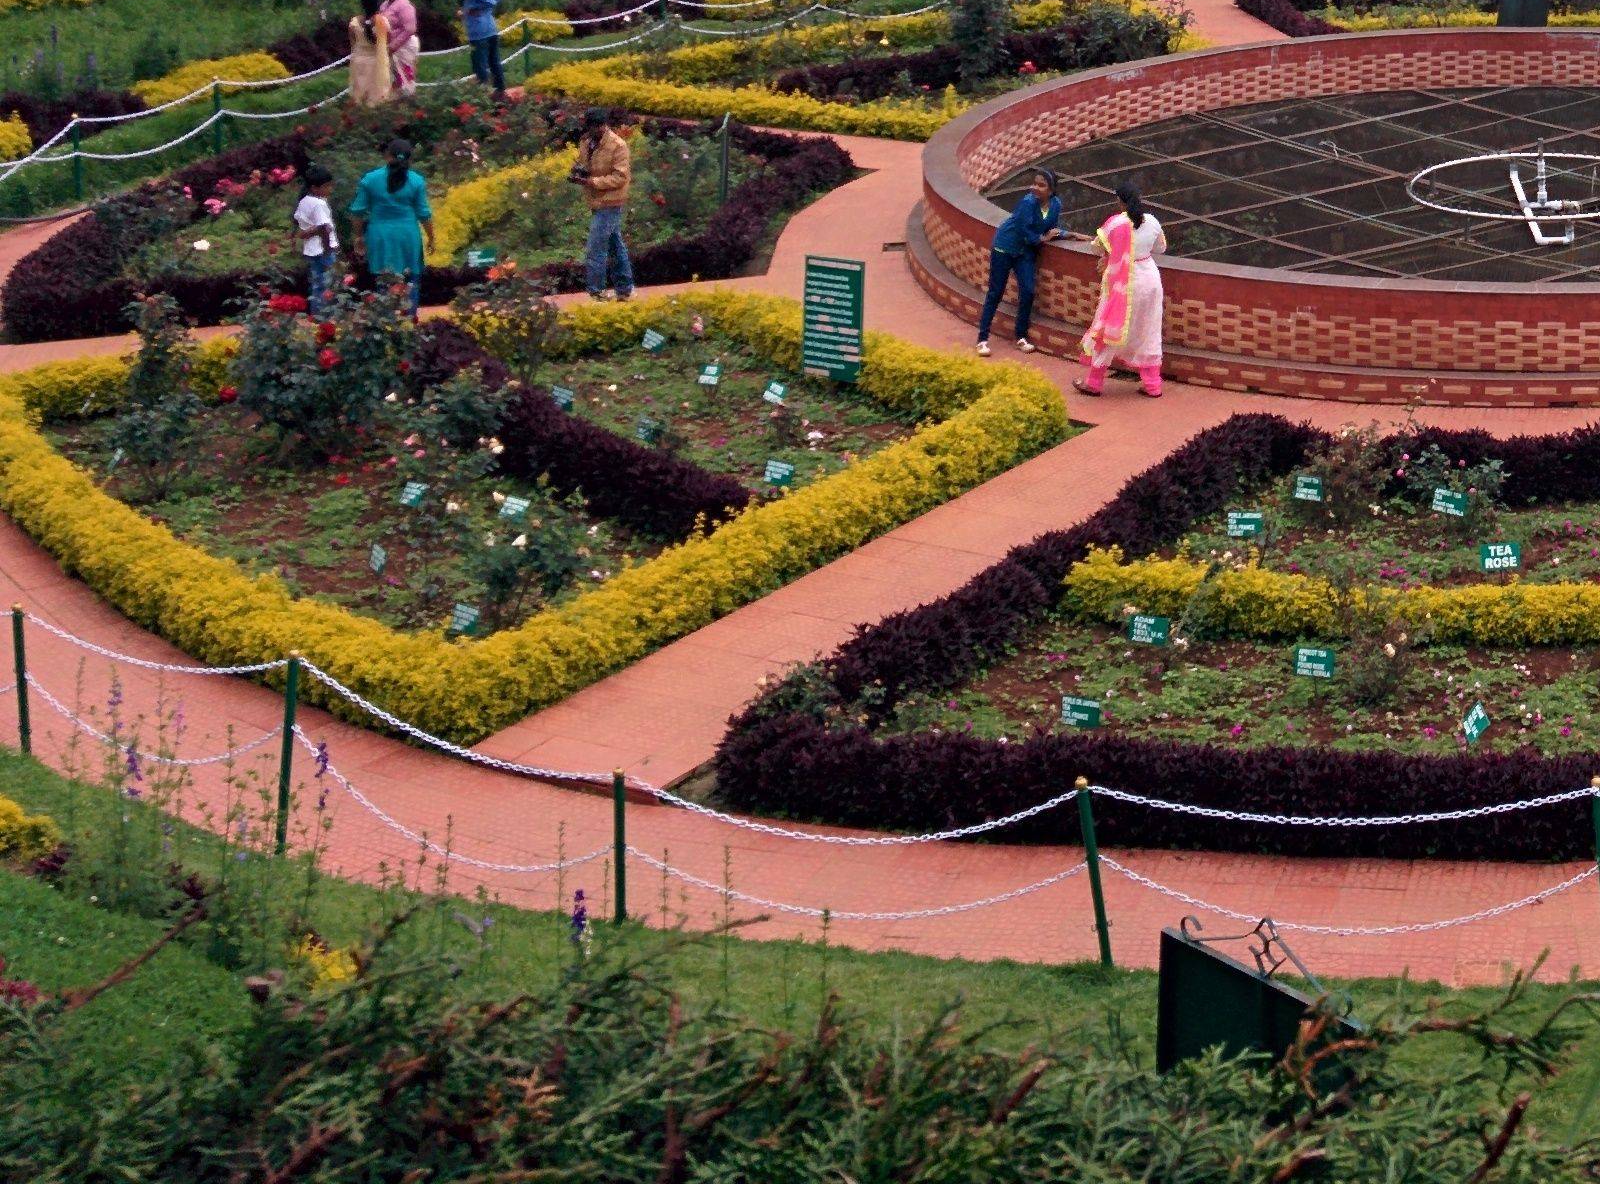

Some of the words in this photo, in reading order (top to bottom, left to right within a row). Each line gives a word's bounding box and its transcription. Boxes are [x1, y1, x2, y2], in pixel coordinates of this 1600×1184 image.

[1488, 545, 1512, 556] TEA
[1485, 556, 1517, 568] ROSE
[1134, 616, 1154, 624] ADAM
[1132, 635, 1153, 643] ADAM
